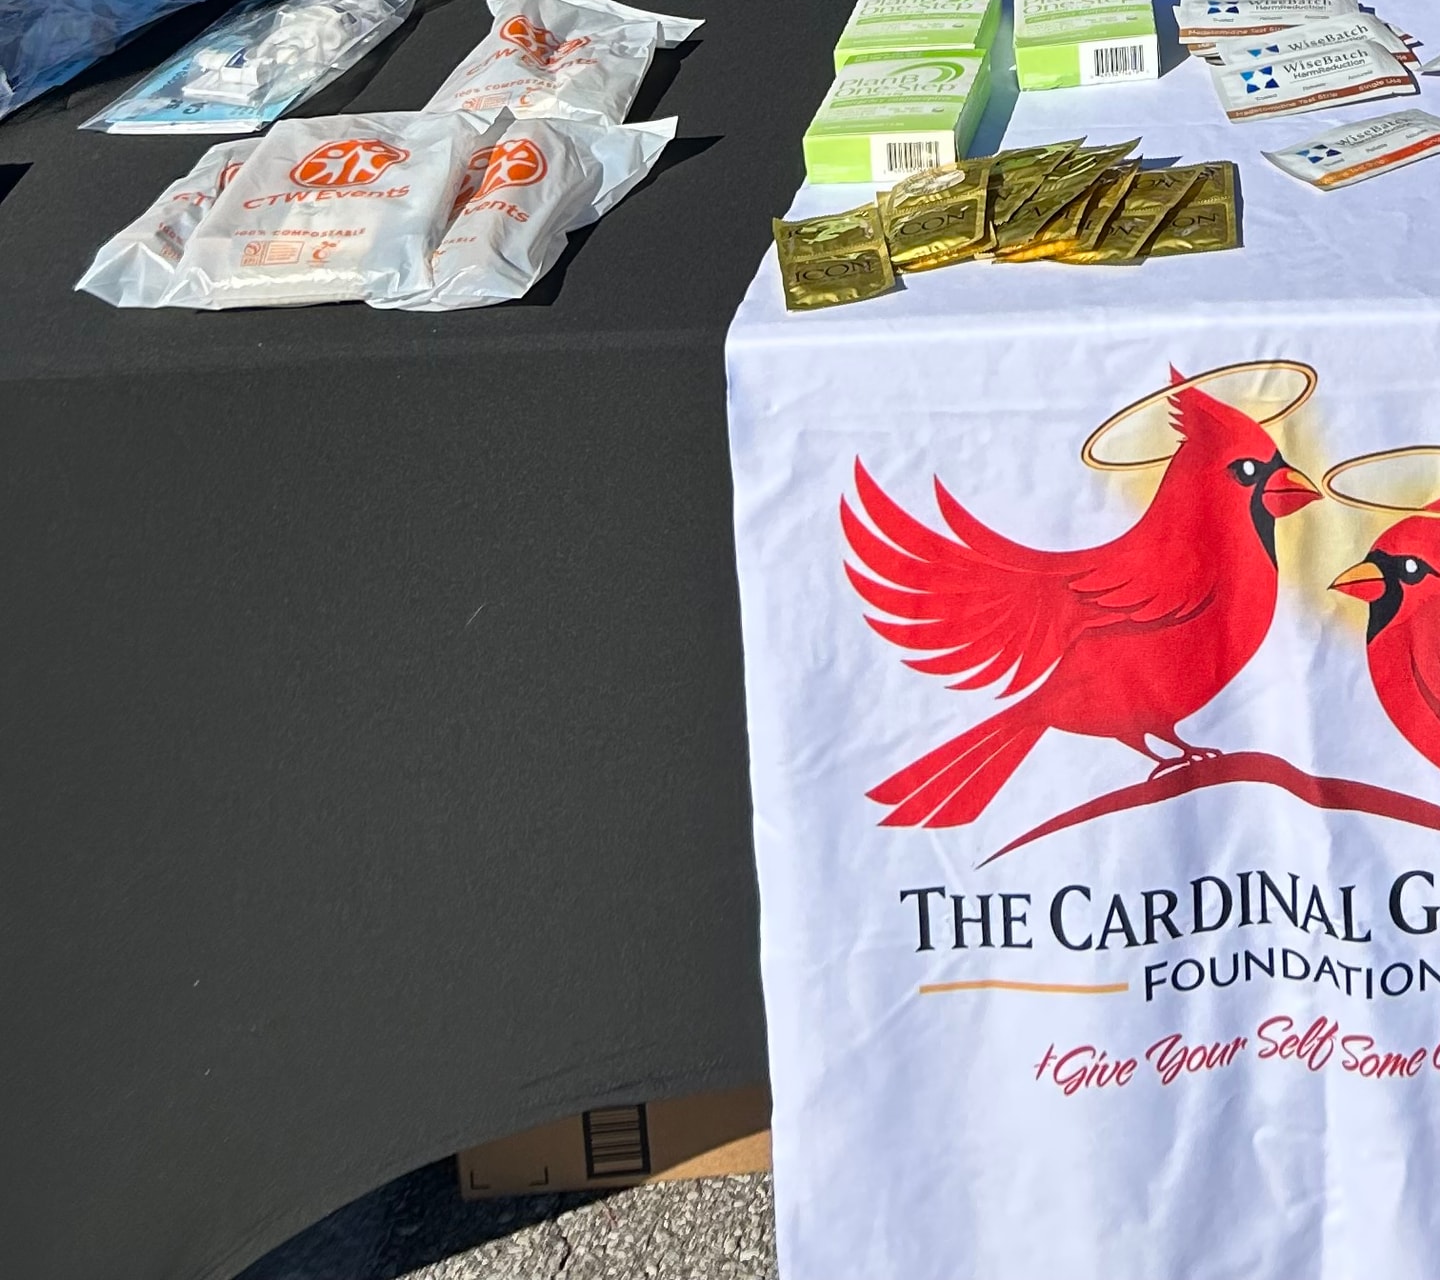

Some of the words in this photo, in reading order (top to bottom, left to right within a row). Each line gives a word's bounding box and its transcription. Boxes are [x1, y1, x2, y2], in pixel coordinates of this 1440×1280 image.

[860, 0, 974, 16] One-Step
[1288, 24, 1368, 52] WiseBatch
[1283, 48, 1368, 74] WiseBatch
[1293, 58, 1366, 80] HarmReduction
[485, 78, 561, 94] COMPOSTABL
[834, 83, 957, 98] One-Step
[242, 190, 314, 210] CTW
[315, 185, 411, 200] Events
[464, 200, 530, 223] vents
[272, 227, 366, 238] COMPOSTABLE
[892, 209, 966, 238] CON
[795, 260, 872, 283] ICON
[900, 884, 1033, 956] THE
[1049, 870, 1372, 954] CARDINAL
[1054, 1033, 1139, 1099] Give
[1144, 1031, 1248, 1086] Your
[1255, 1013, 1343, 1071] Self
[1341, 1034, 1429, 1080] Some
